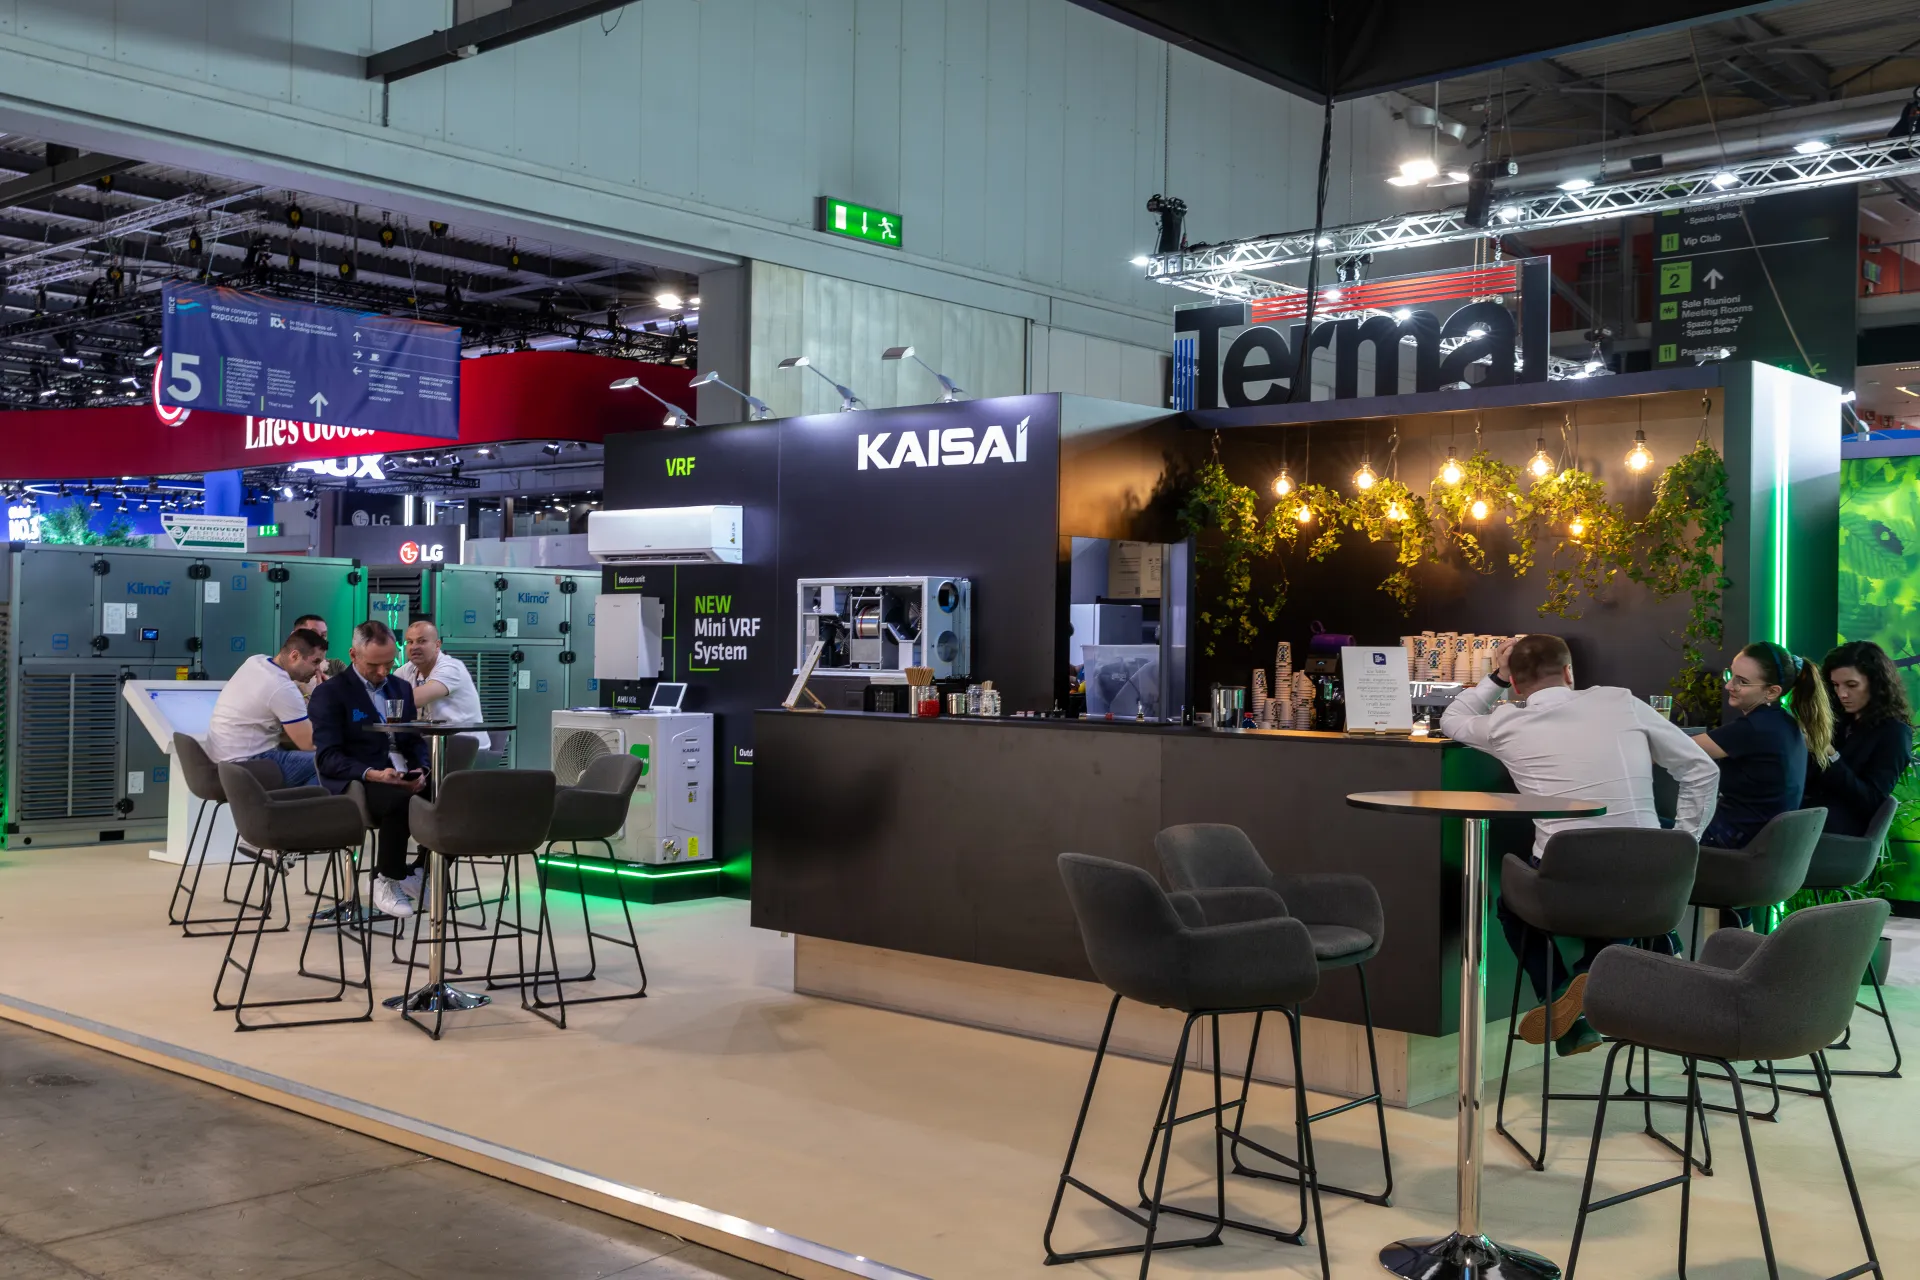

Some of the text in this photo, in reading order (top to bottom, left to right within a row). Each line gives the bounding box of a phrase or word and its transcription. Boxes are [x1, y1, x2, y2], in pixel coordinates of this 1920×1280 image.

[1722, 199, 1756, 208] Rooms
[1689, 211, 1743, 225] Spazio Delta-7
[1683, 234, 1722, 246] Vip Club
[1669, 273, 1680, 289] 2
[1681, 295, 1741, 309] Sale Riunioni
[210, 312, 258, 325] expocomfort
[1681, 305, 1753, 319] Meeting Rooms
[1686, 317, 1743, 329] Spazio Alpha-7
[1175, 255, 1550, 410] Termal
[1686, 325, 1738, 337] Spazio Beta-7
[166, 352, 201, 402] 5
[858, 415, 1031, 470] KAISAI
[665, 457, 696, 477] VRF
[372, 514, 391, 526] LG
[421, 544, 444, 561] LG
[127, 582, 170, 595] Klimor
[518, 592, 549, 604] Klimor
[695, 595, 732, 614] NEW
[373, 600, 405, 612] Klimor
[694, 617, 761, 637] Mini VRF
[694, 641, 747, 664] System
